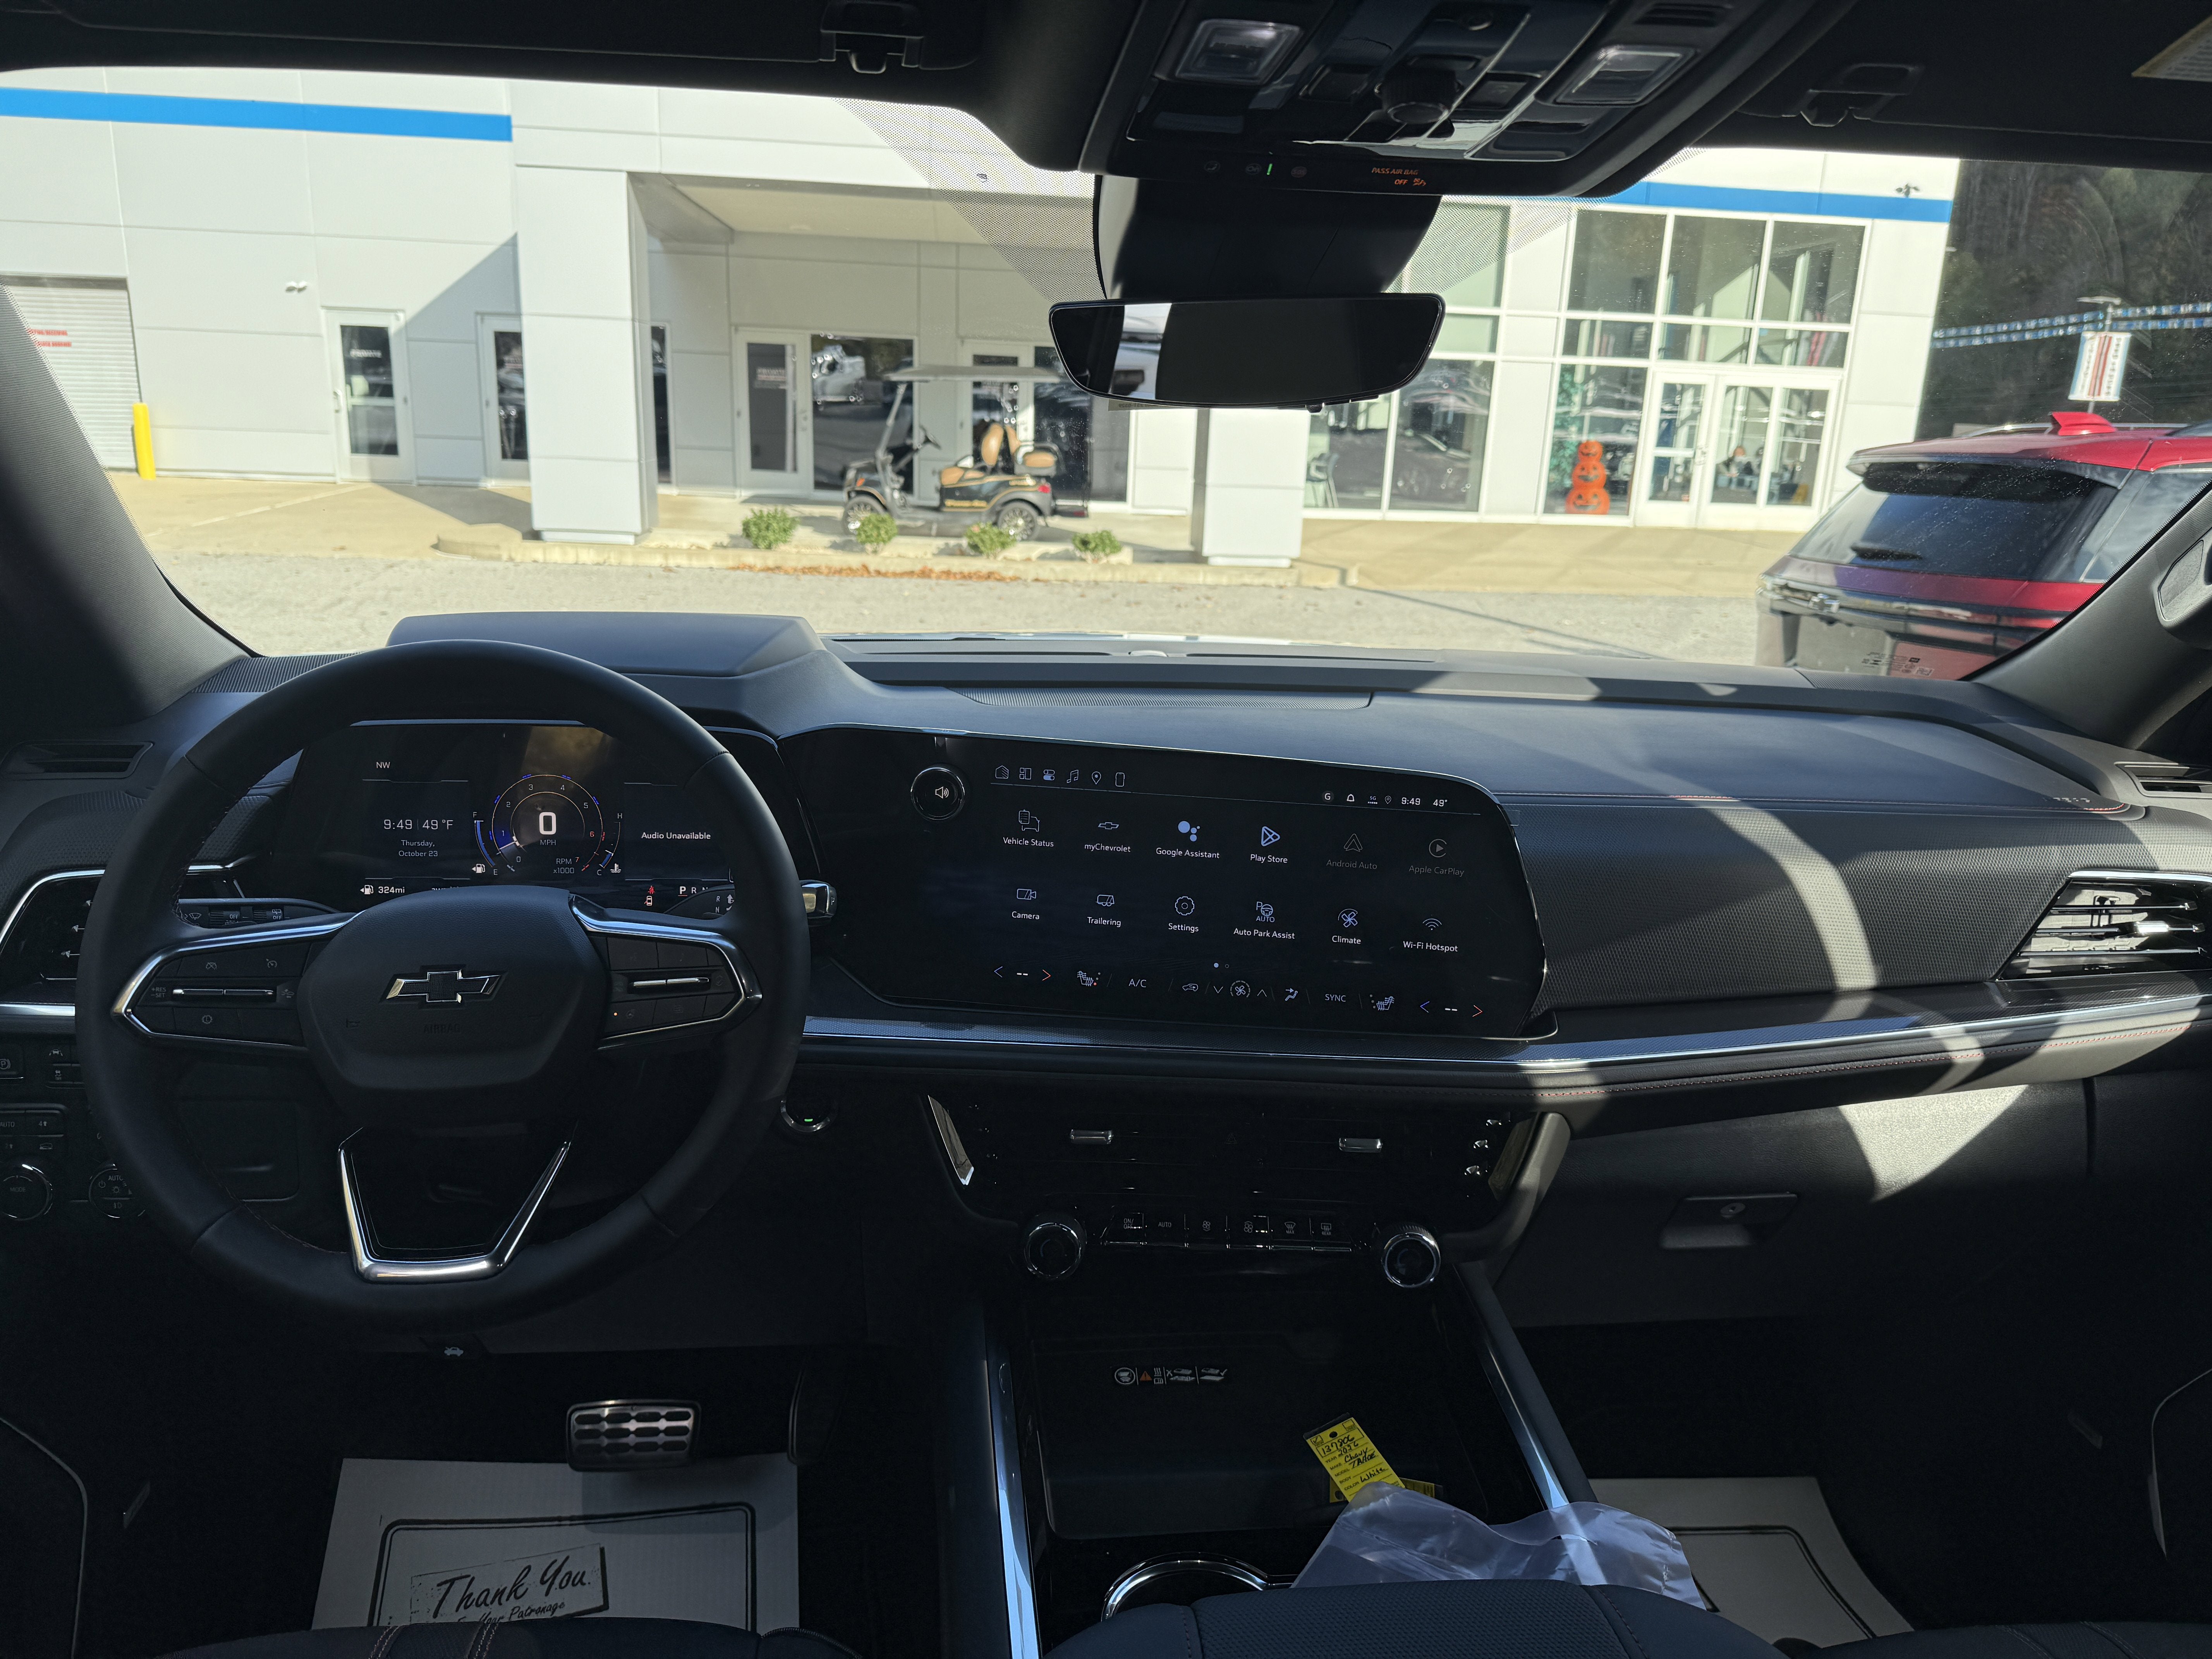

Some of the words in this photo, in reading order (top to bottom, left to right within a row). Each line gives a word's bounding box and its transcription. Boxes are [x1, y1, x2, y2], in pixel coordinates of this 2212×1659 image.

[384, 820, 412, 829] 9:49
[539, 812, 556, 835] 0
[1085, 843, 1130, 852] myChevrolet
[1156, 848, 1182, 857] Google
[1185, 850, 1219, 858] Assistant
[1251, 854, 1266, 863] Play
[1409, 866, 1431, 874] Apple
[1434, 867, 1464, 877] CarPlay
[1012, 911, 1039, 919] Camera
[1087, 917, 1121, 927] Trailering
[1169, 923, 1199, 933] Settings
[1332, 936, 1361, 944] Climate
[1426, 943, 1458, 952] Hotspot
[1129, 979, 1146, 987] A/C
[1345, 1481, 1359, 1490] COLOR
[1360, 1467, 1385, 1482] White
[432, 1564, 532, 1619] Thank
[510, 1601, 565, 1620] Patronage
